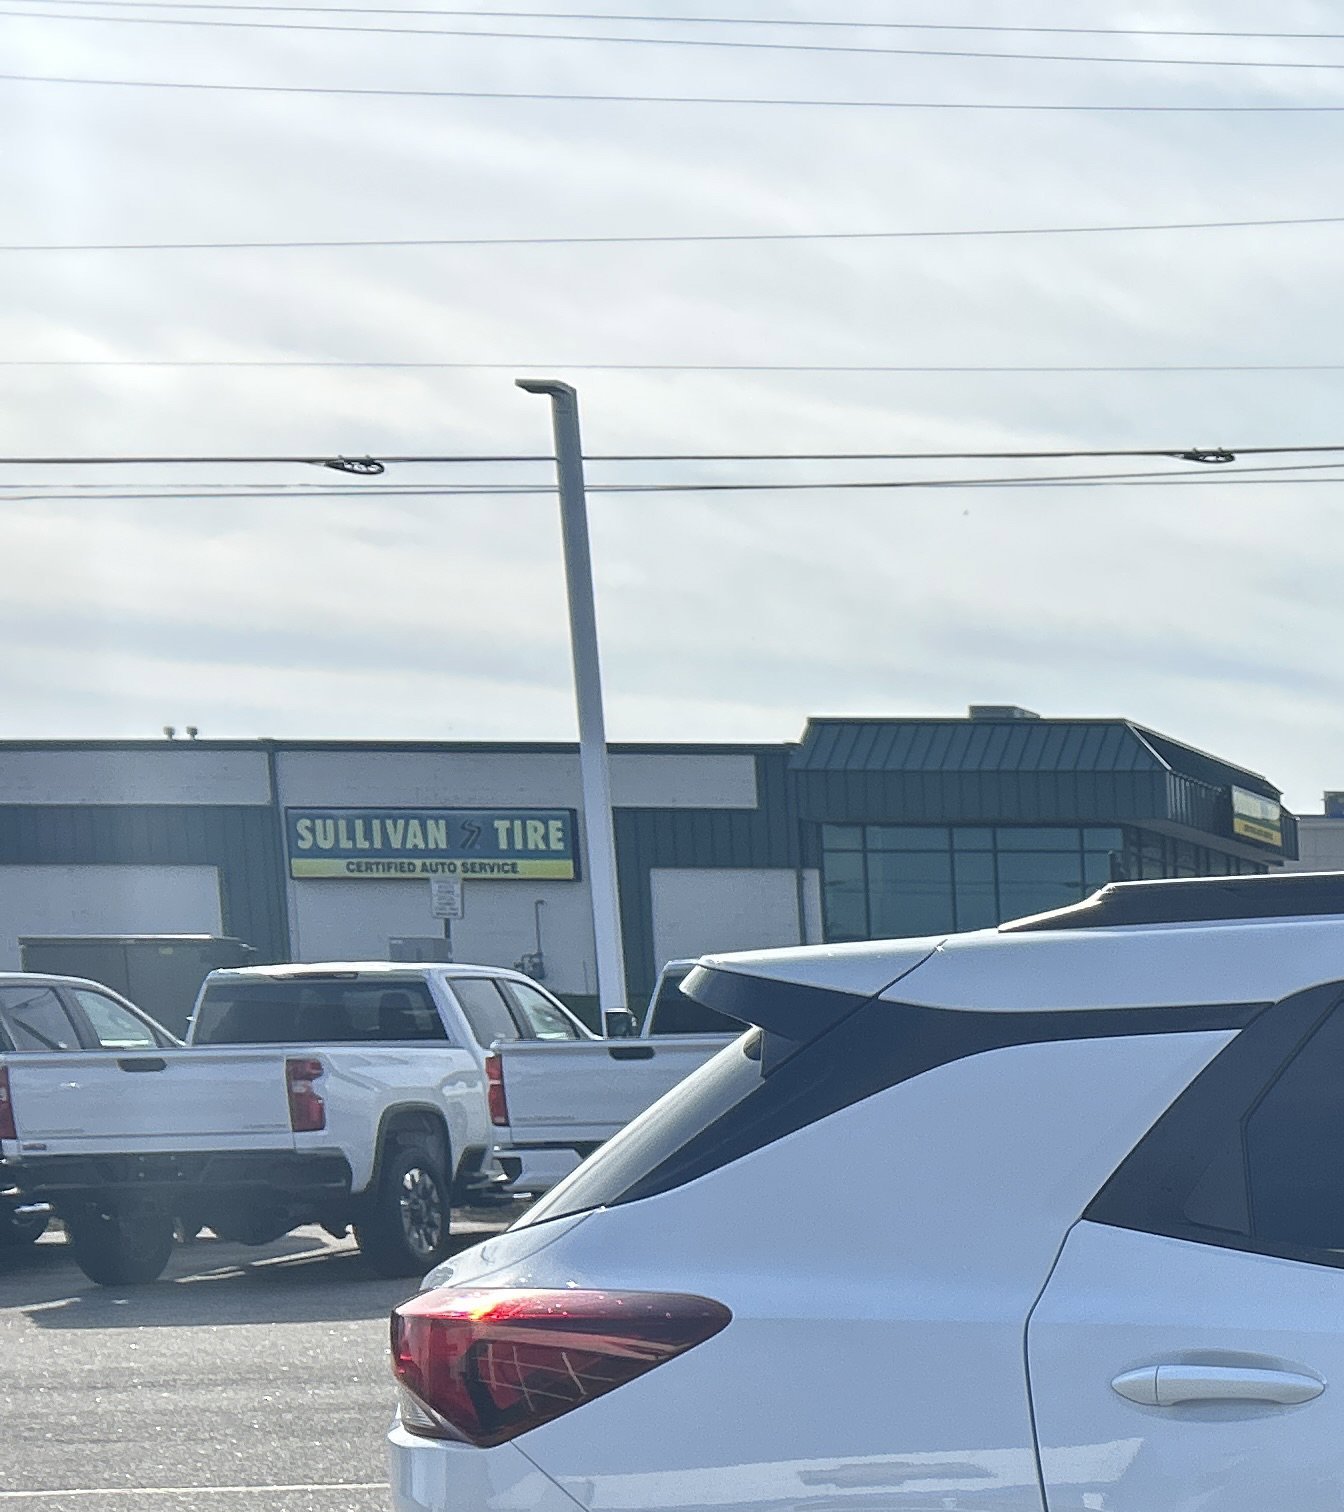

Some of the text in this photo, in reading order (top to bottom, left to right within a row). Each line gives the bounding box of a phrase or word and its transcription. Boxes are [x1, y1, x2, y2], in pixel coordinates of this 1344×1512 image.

[297, 819, 565, 850] SULLIVAN TIRE
[346, 861, 519, 874] CERTIFIED AUTO SERVICE
